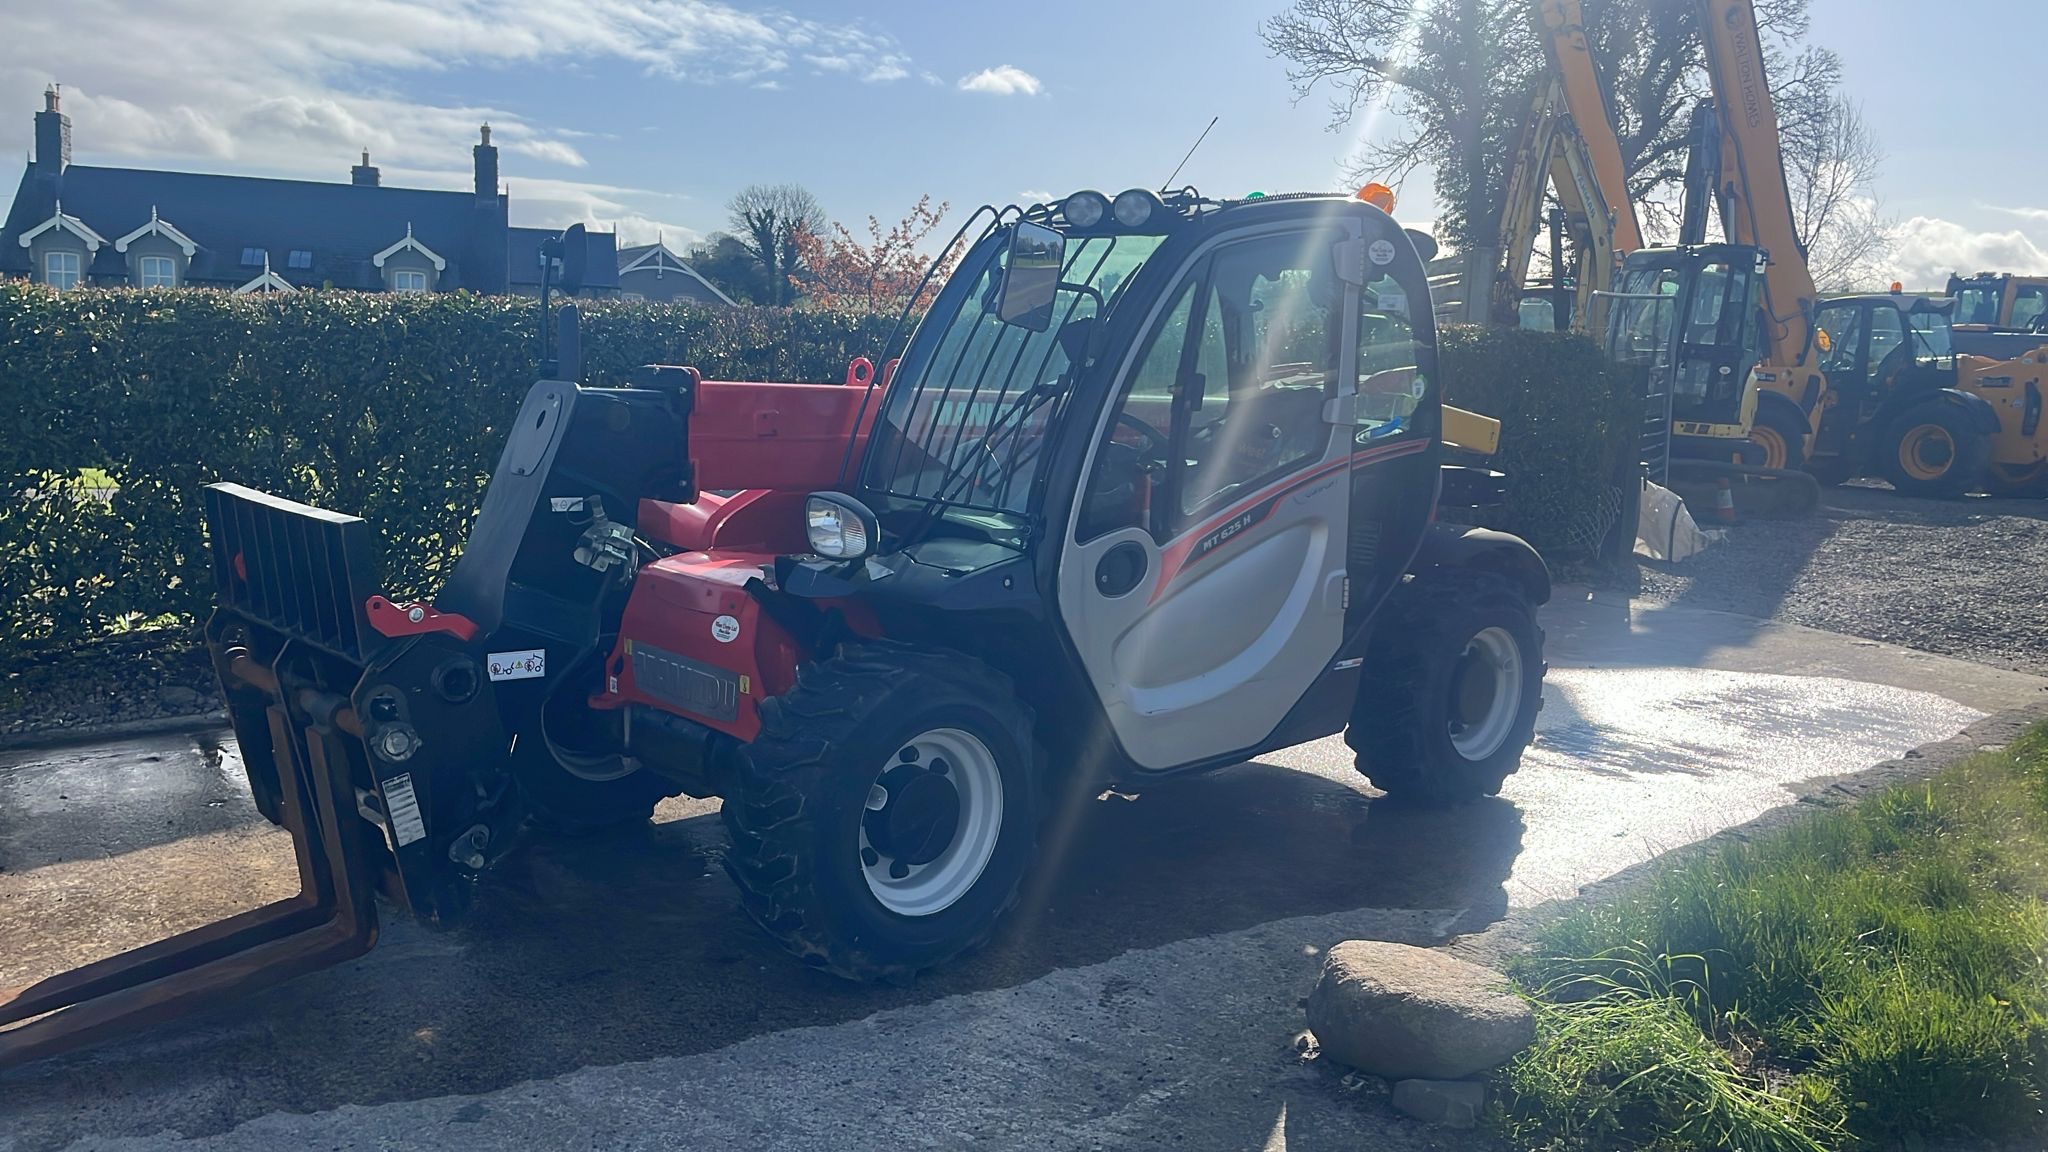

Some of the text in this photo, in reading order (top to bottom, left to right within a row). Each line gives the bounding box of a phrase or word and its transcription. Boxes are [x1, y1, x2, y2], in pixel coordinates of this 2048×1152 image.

[1744, 85, 1760, 128] HOMES
[1203, 514, 1251, 551] MT 625 H
